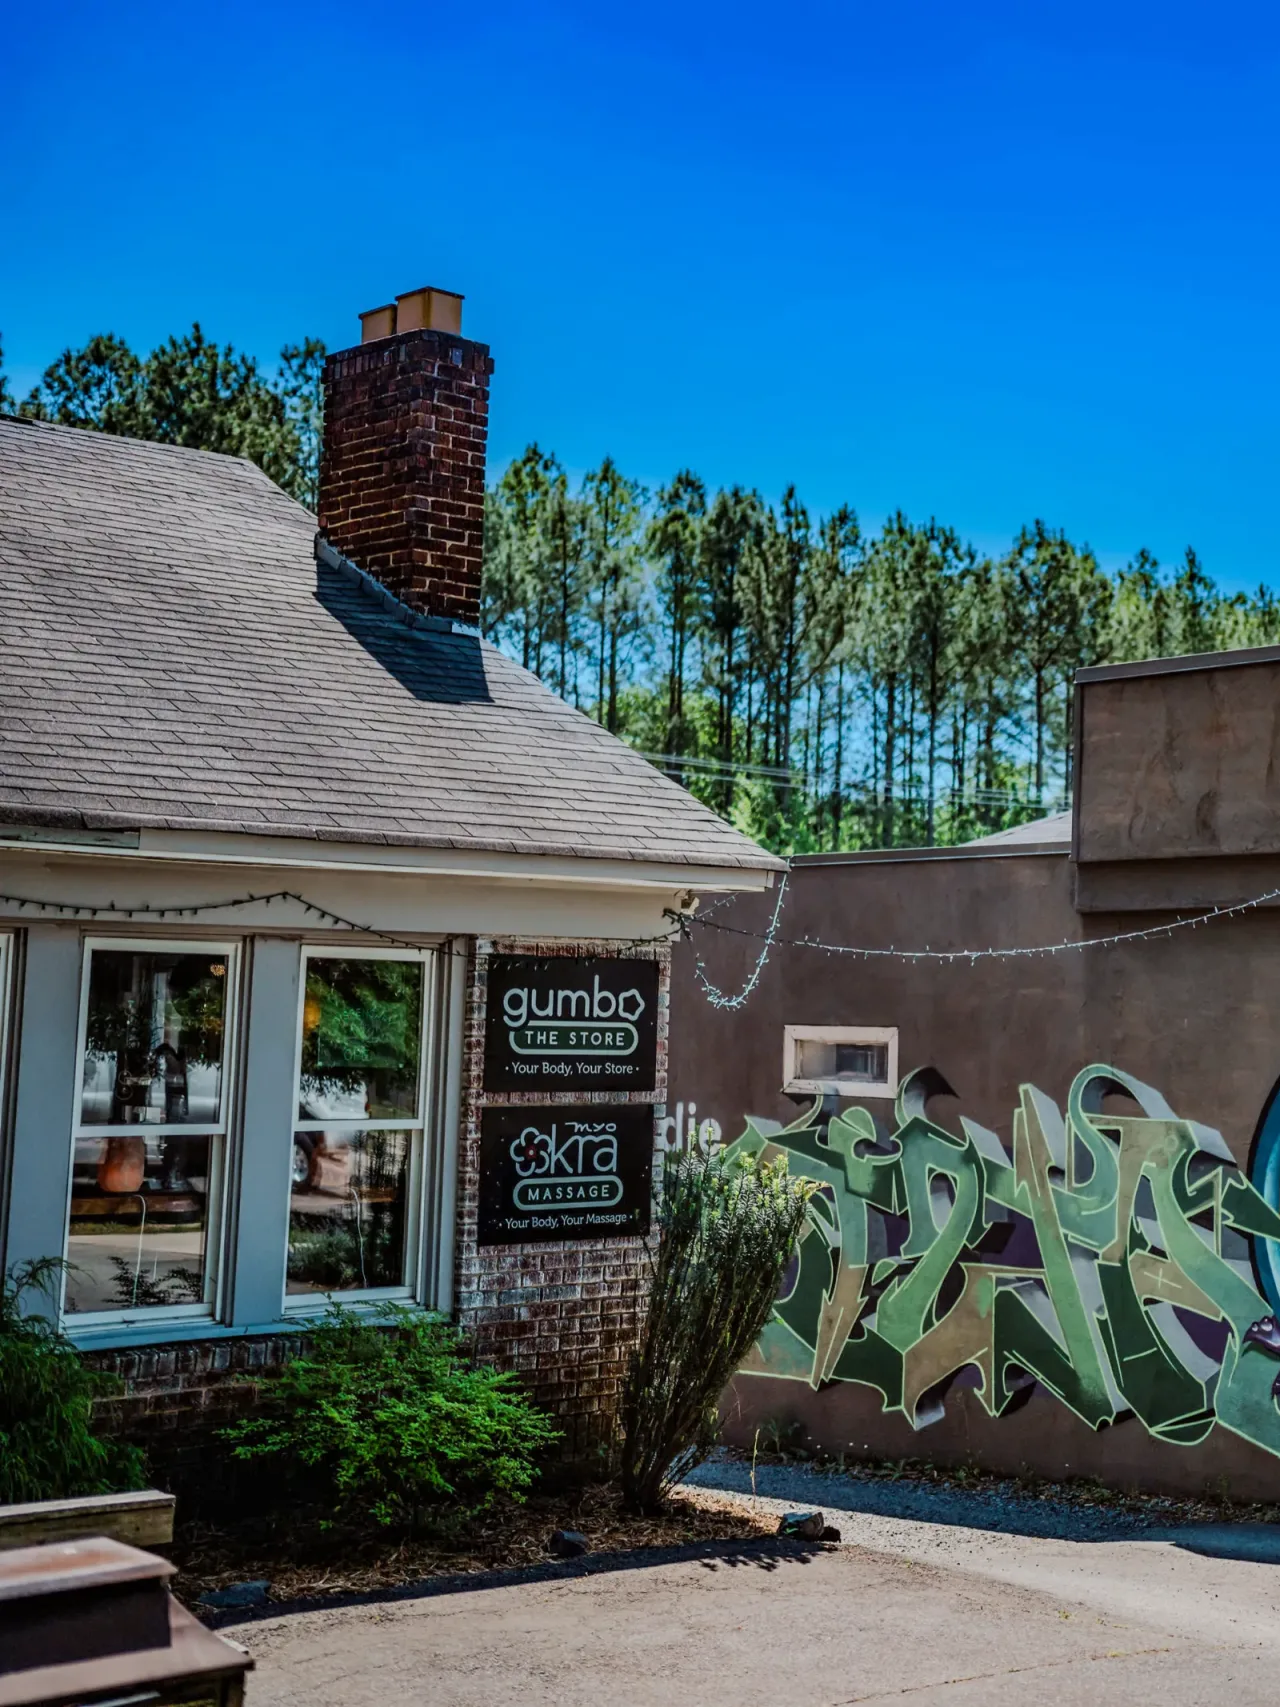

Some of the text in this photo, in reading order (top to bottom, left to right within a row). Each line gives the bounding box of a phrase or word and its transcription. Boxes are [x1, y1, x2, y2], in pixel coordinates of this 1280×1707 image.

[503, 975, 646, 1028] gumbo
[525, 1031, 625, 1047] THE STORE
[511, 1061, 633, 1077] Your Body, Your Store
[528, 1184, 611, 1201] MASSAGE
[505, 1212, 627, 1230] Your Body, Your Massage
